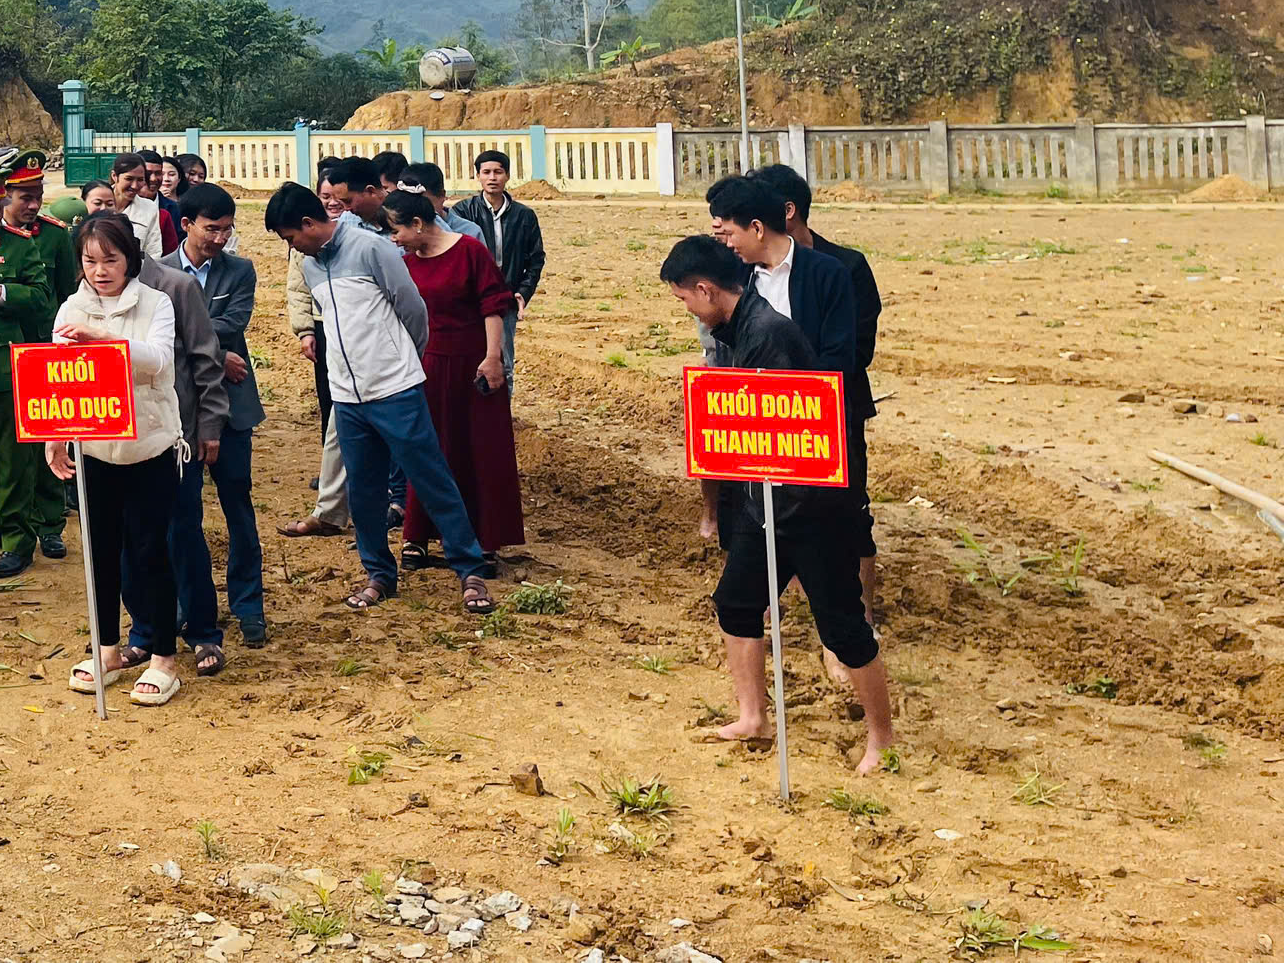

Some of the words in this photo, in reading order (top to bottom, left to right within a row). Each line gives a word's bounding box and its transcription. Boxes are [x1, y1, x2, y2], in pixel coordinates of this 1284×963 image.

[46, 352, 95, 383] KHỐI
[27, 394, 75, 421] GIÁO
[79, 396, 122, 424] DỤC
[707, 384, 757, 416] KHỐI
[761, 390, 822, 420] ĐOÀN
[701, 428, 773, 455] THANH
[777, 429, 830, 459] NIÊN
